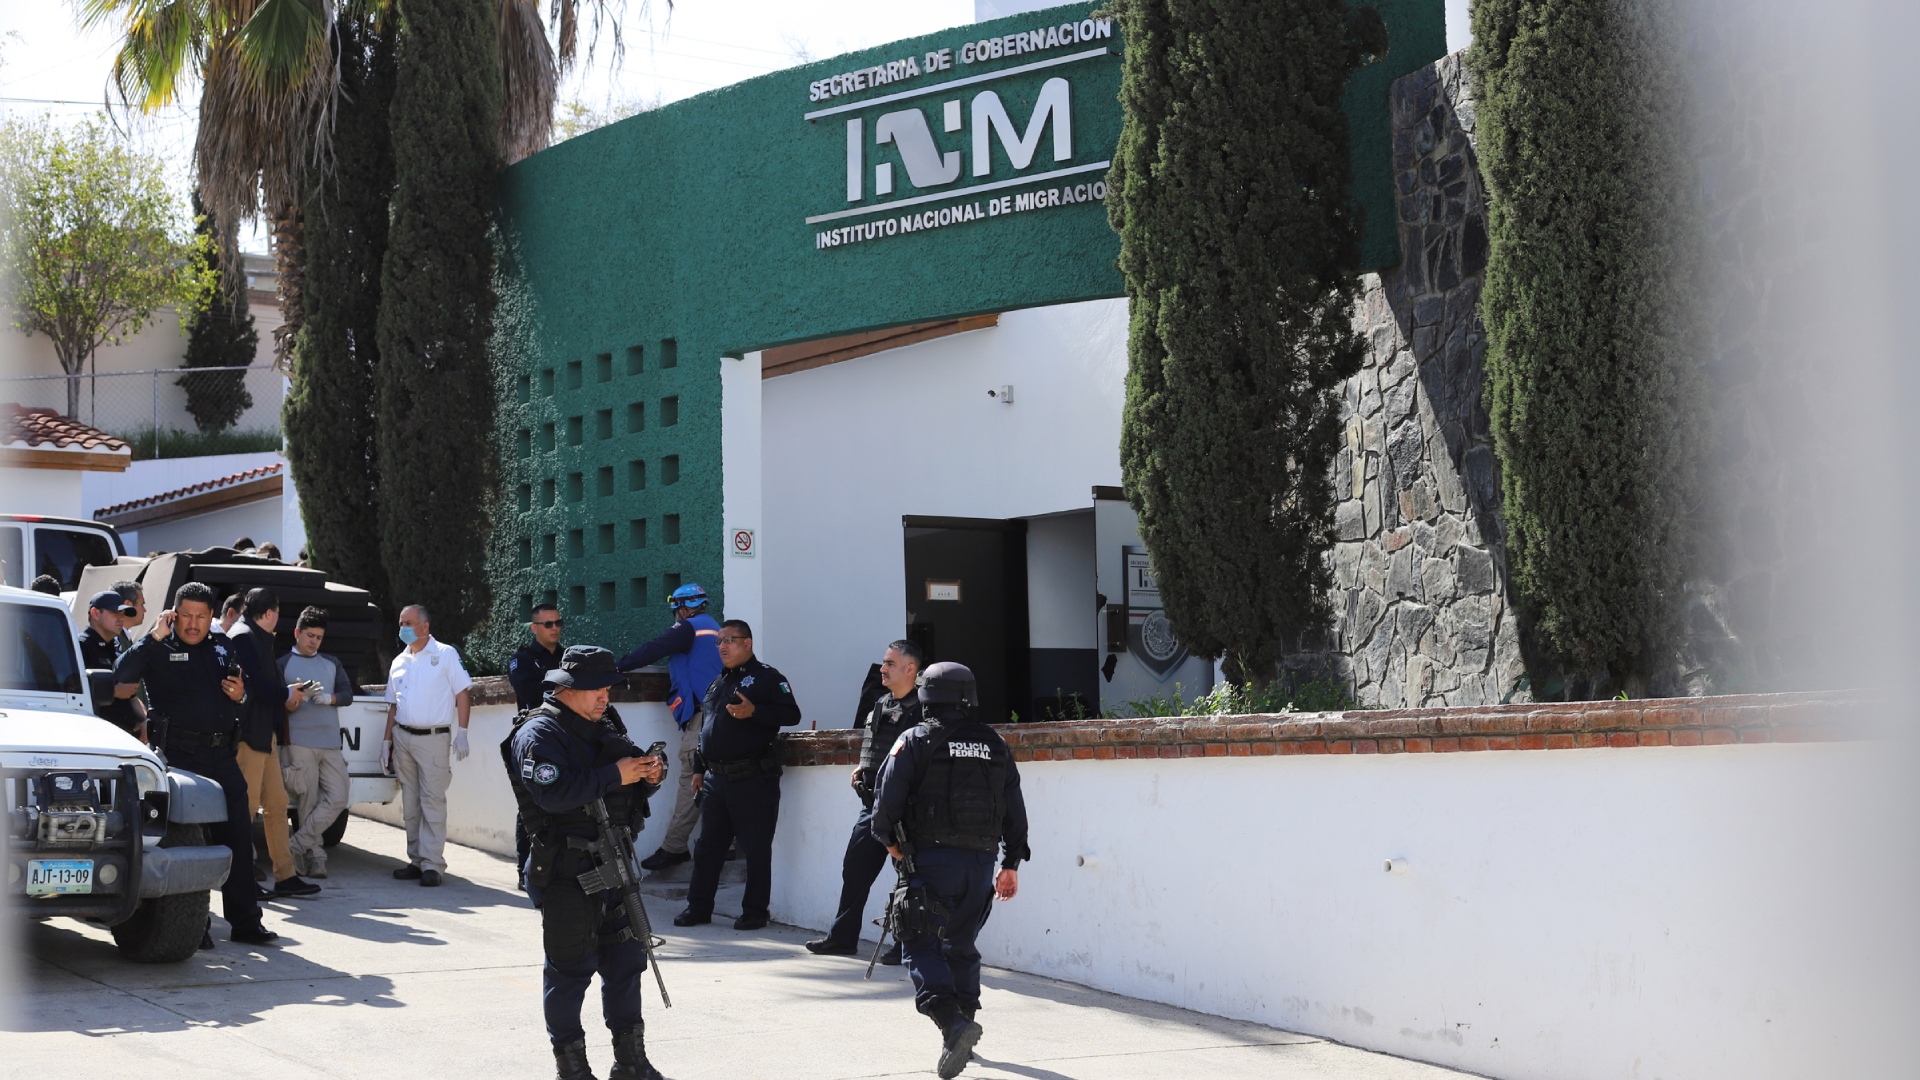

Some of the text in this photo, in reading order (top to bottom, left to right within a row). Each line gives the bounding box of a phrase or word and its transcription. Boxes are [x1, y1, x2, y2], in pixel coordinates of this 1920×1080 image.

[809, 17, 1111, 102] SECRETARIA DE GOBERNACION
[816, 181, 1107, 249] INSTITUTO NACIONAL DE MIGRACIO
[340, 726, 361, 751] N
[29, 756, 59, 767] Jeep
[950, 749, 992, 760] FEDERAL
[32, 869, 90, 885] AJT-13-09
